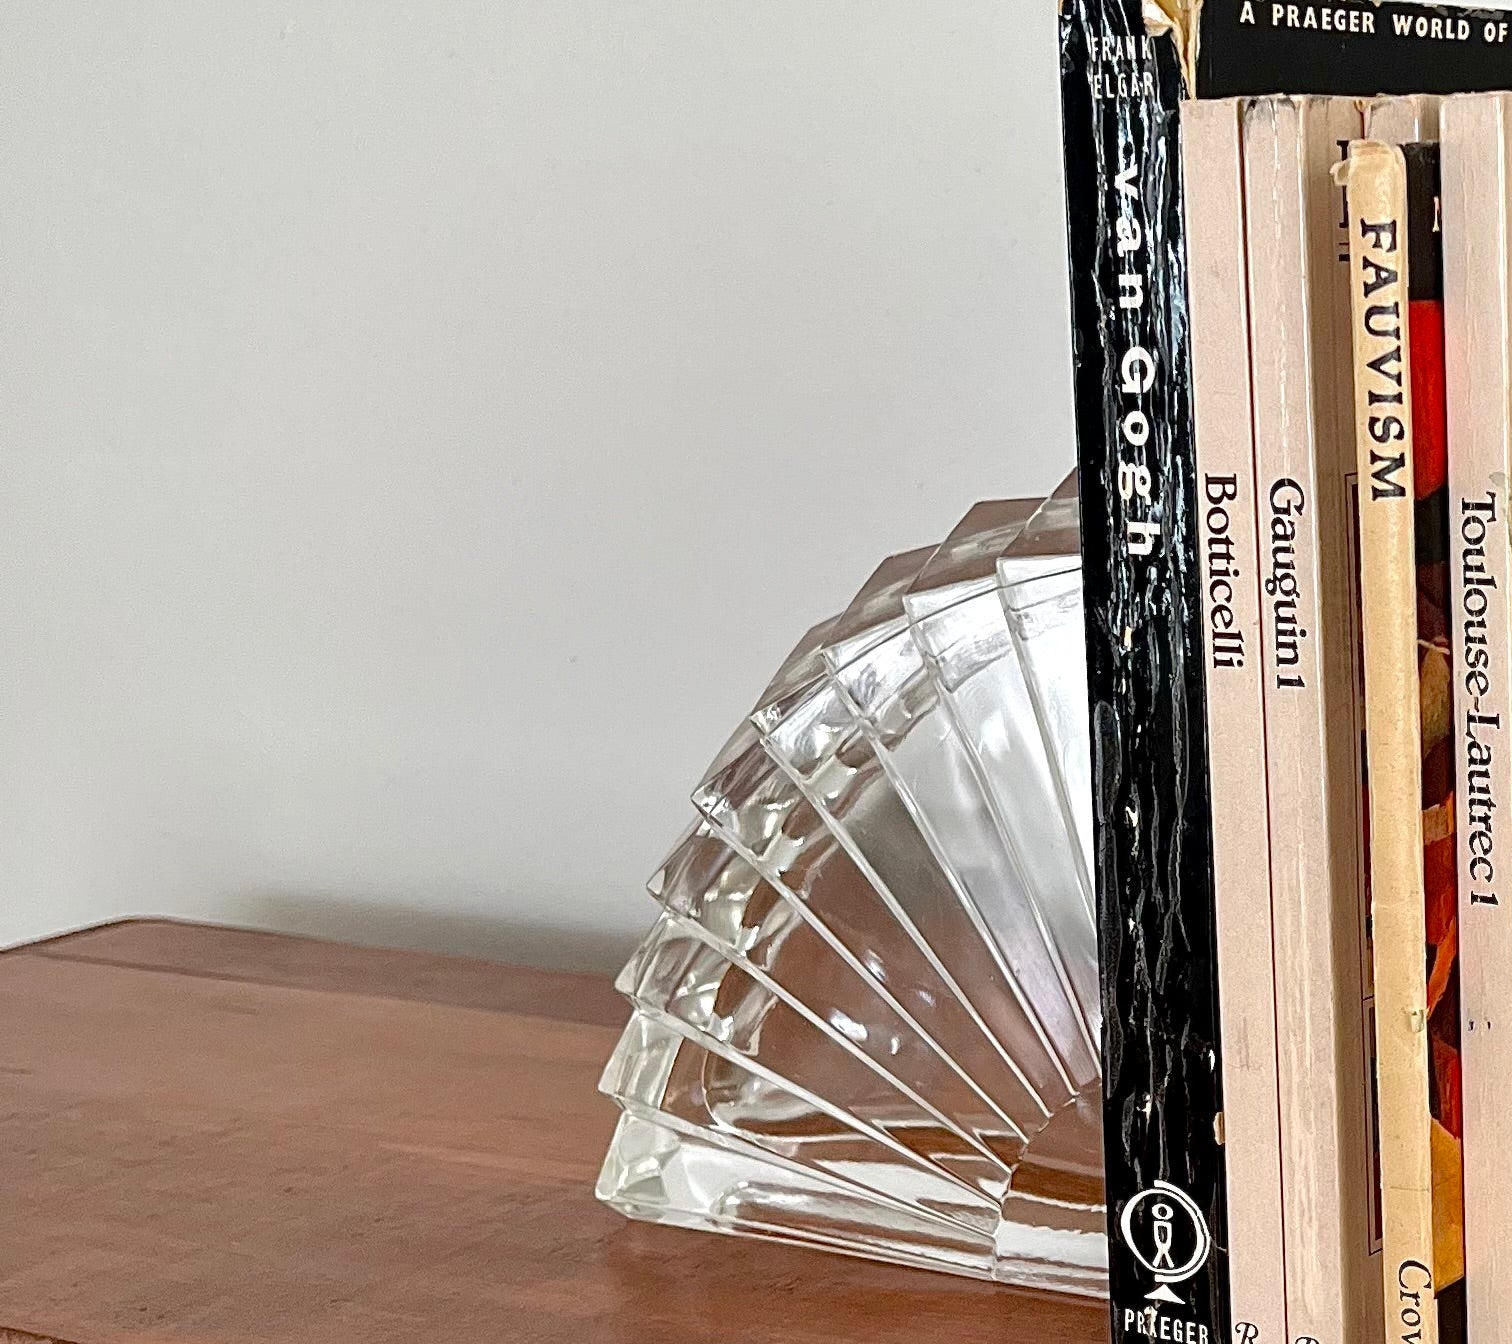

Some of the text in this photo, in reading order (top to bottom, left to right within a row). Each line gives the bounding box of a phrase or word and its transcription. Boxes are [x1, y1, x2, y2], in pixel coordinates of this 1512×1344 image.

[1091, 34, 1153, 62] FRANK
[1093, 72, 1154, 99] ELGAR
[1239, 1, 1256, 25] A
[1272, 3, 1376, 34] PRAEGER
[1393, 14, 1470, 41] WORLD
[1484, 22, 1509, 42] OF
[1113, 164, 1162, 557] van Gogh
[1360, 218, 1407, 502] FAUVISM
[1204, 472, 1245, 669] Botticelli
[1264, 477, 1307, 690] Gauguin 1
[1461, 491, 1501, 906] Toulouse-Lautrec 1
